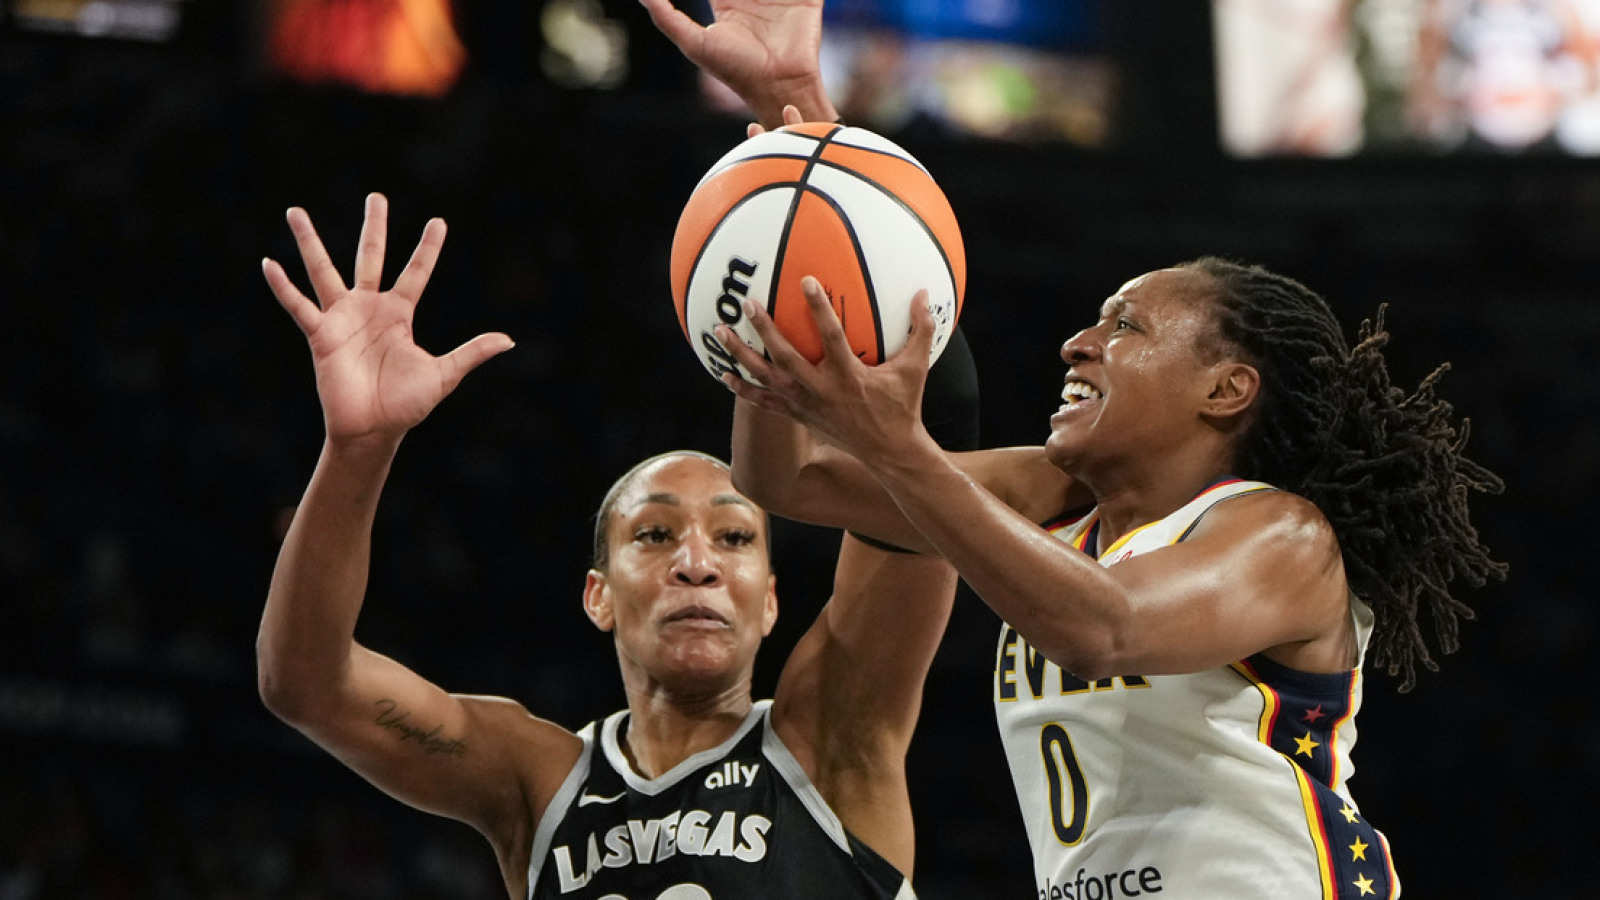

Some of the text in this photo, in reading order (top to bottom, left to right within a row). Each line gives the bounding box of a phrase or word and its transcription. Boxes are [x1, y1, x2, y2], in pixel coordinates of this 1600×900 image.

[704, 761, 760, 789] ally
[1042, 722, 1089, 846] 0
[1039, 866, 1163, 900] alesforce
